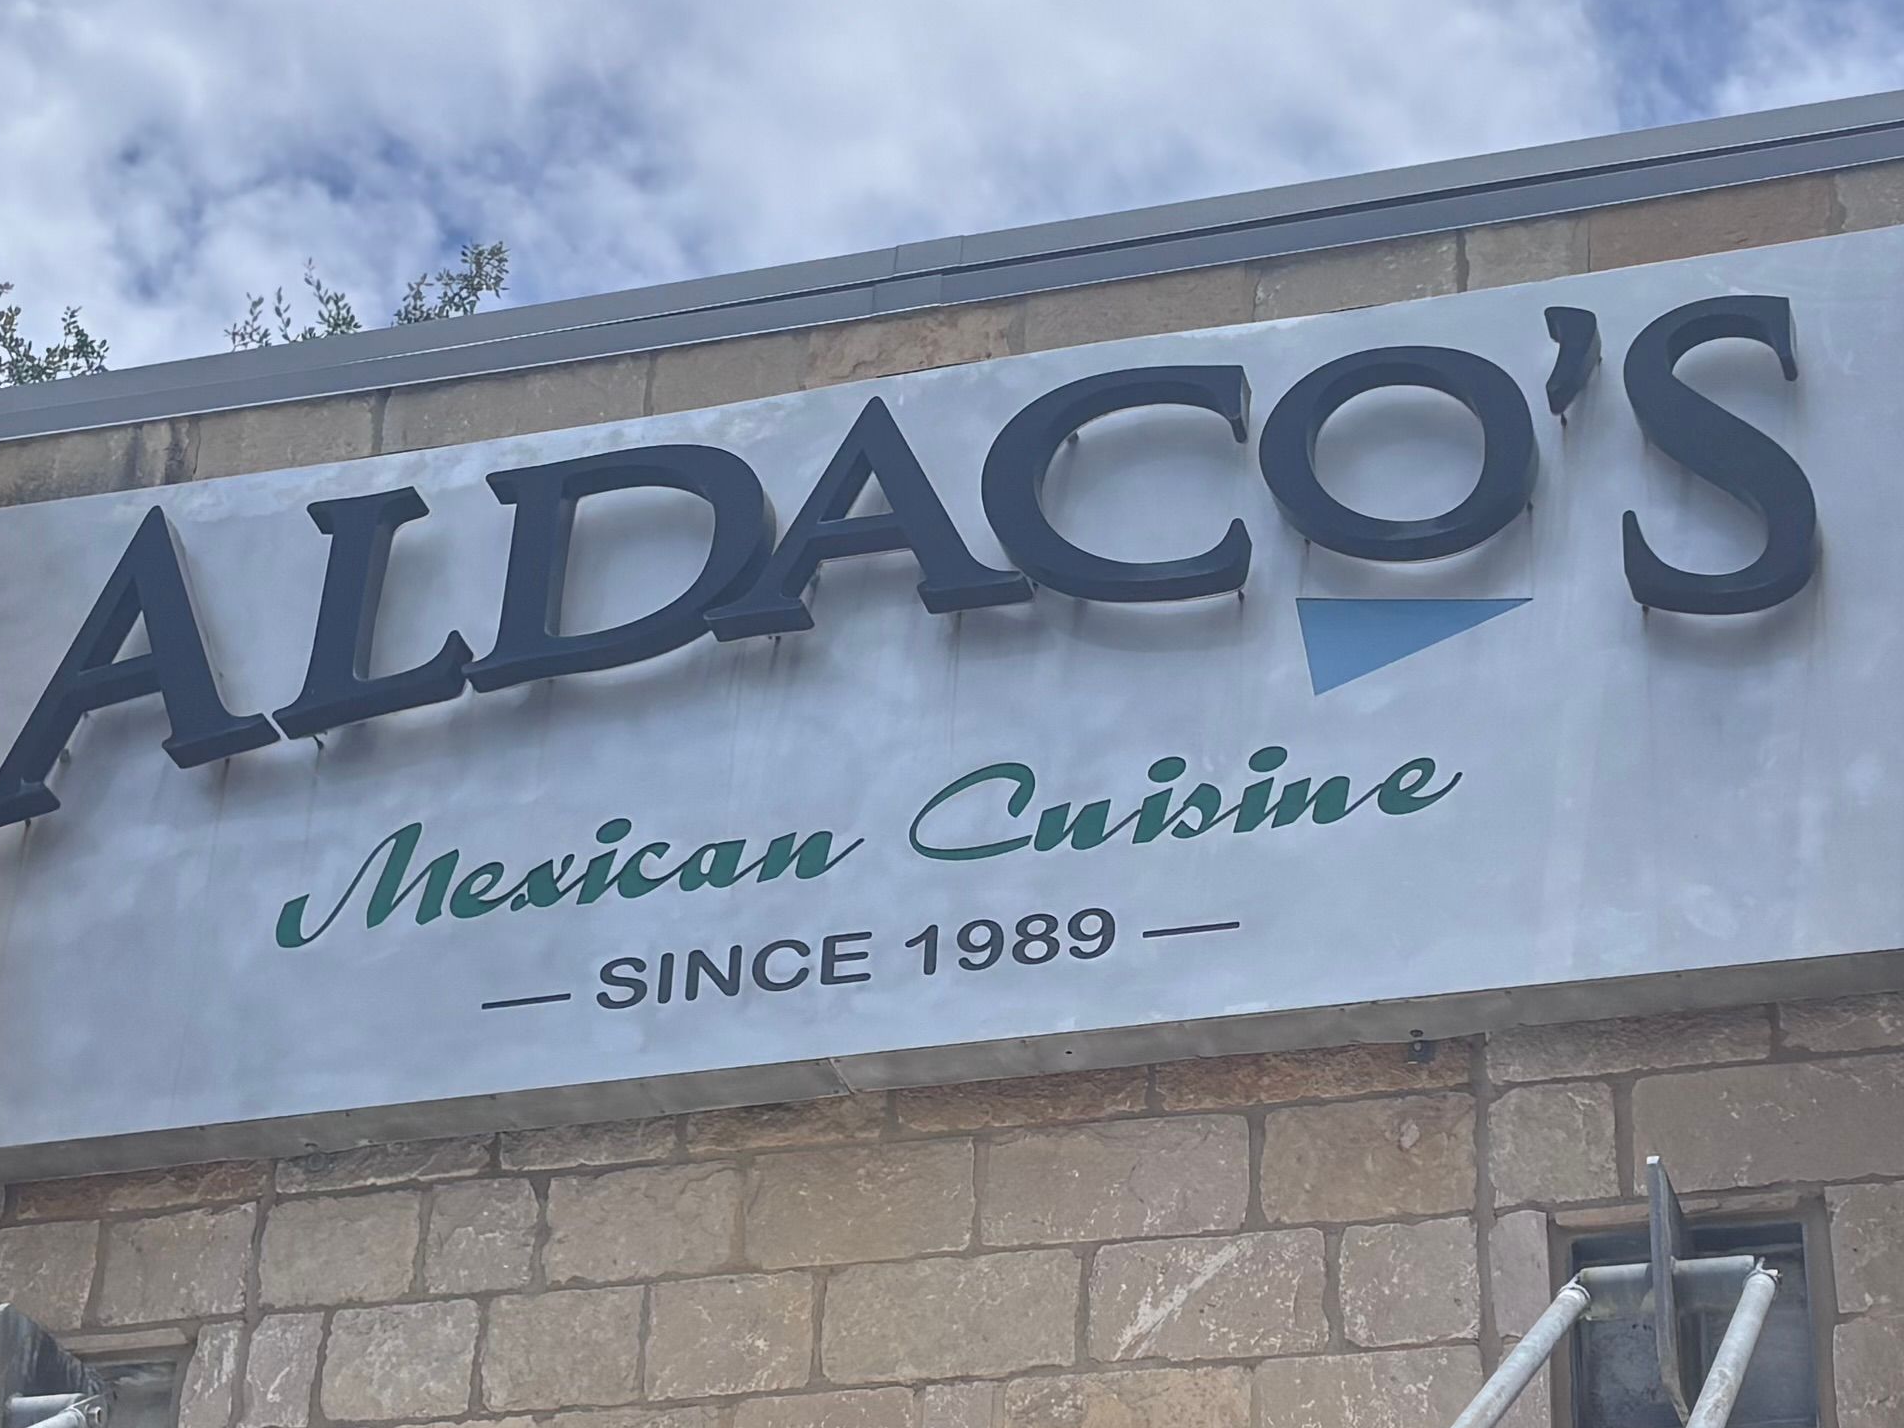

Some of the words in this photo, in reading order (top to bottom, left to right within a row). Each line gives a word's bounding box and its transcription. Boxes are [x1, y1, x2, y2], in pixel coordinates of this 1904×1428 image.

[274, 818, 866, 949] Mexican
[908, 745, 1464, 862] Cuisine
[595, 930, 873, 1011] SINCE
[904, 906, 1119, 977] 1989
